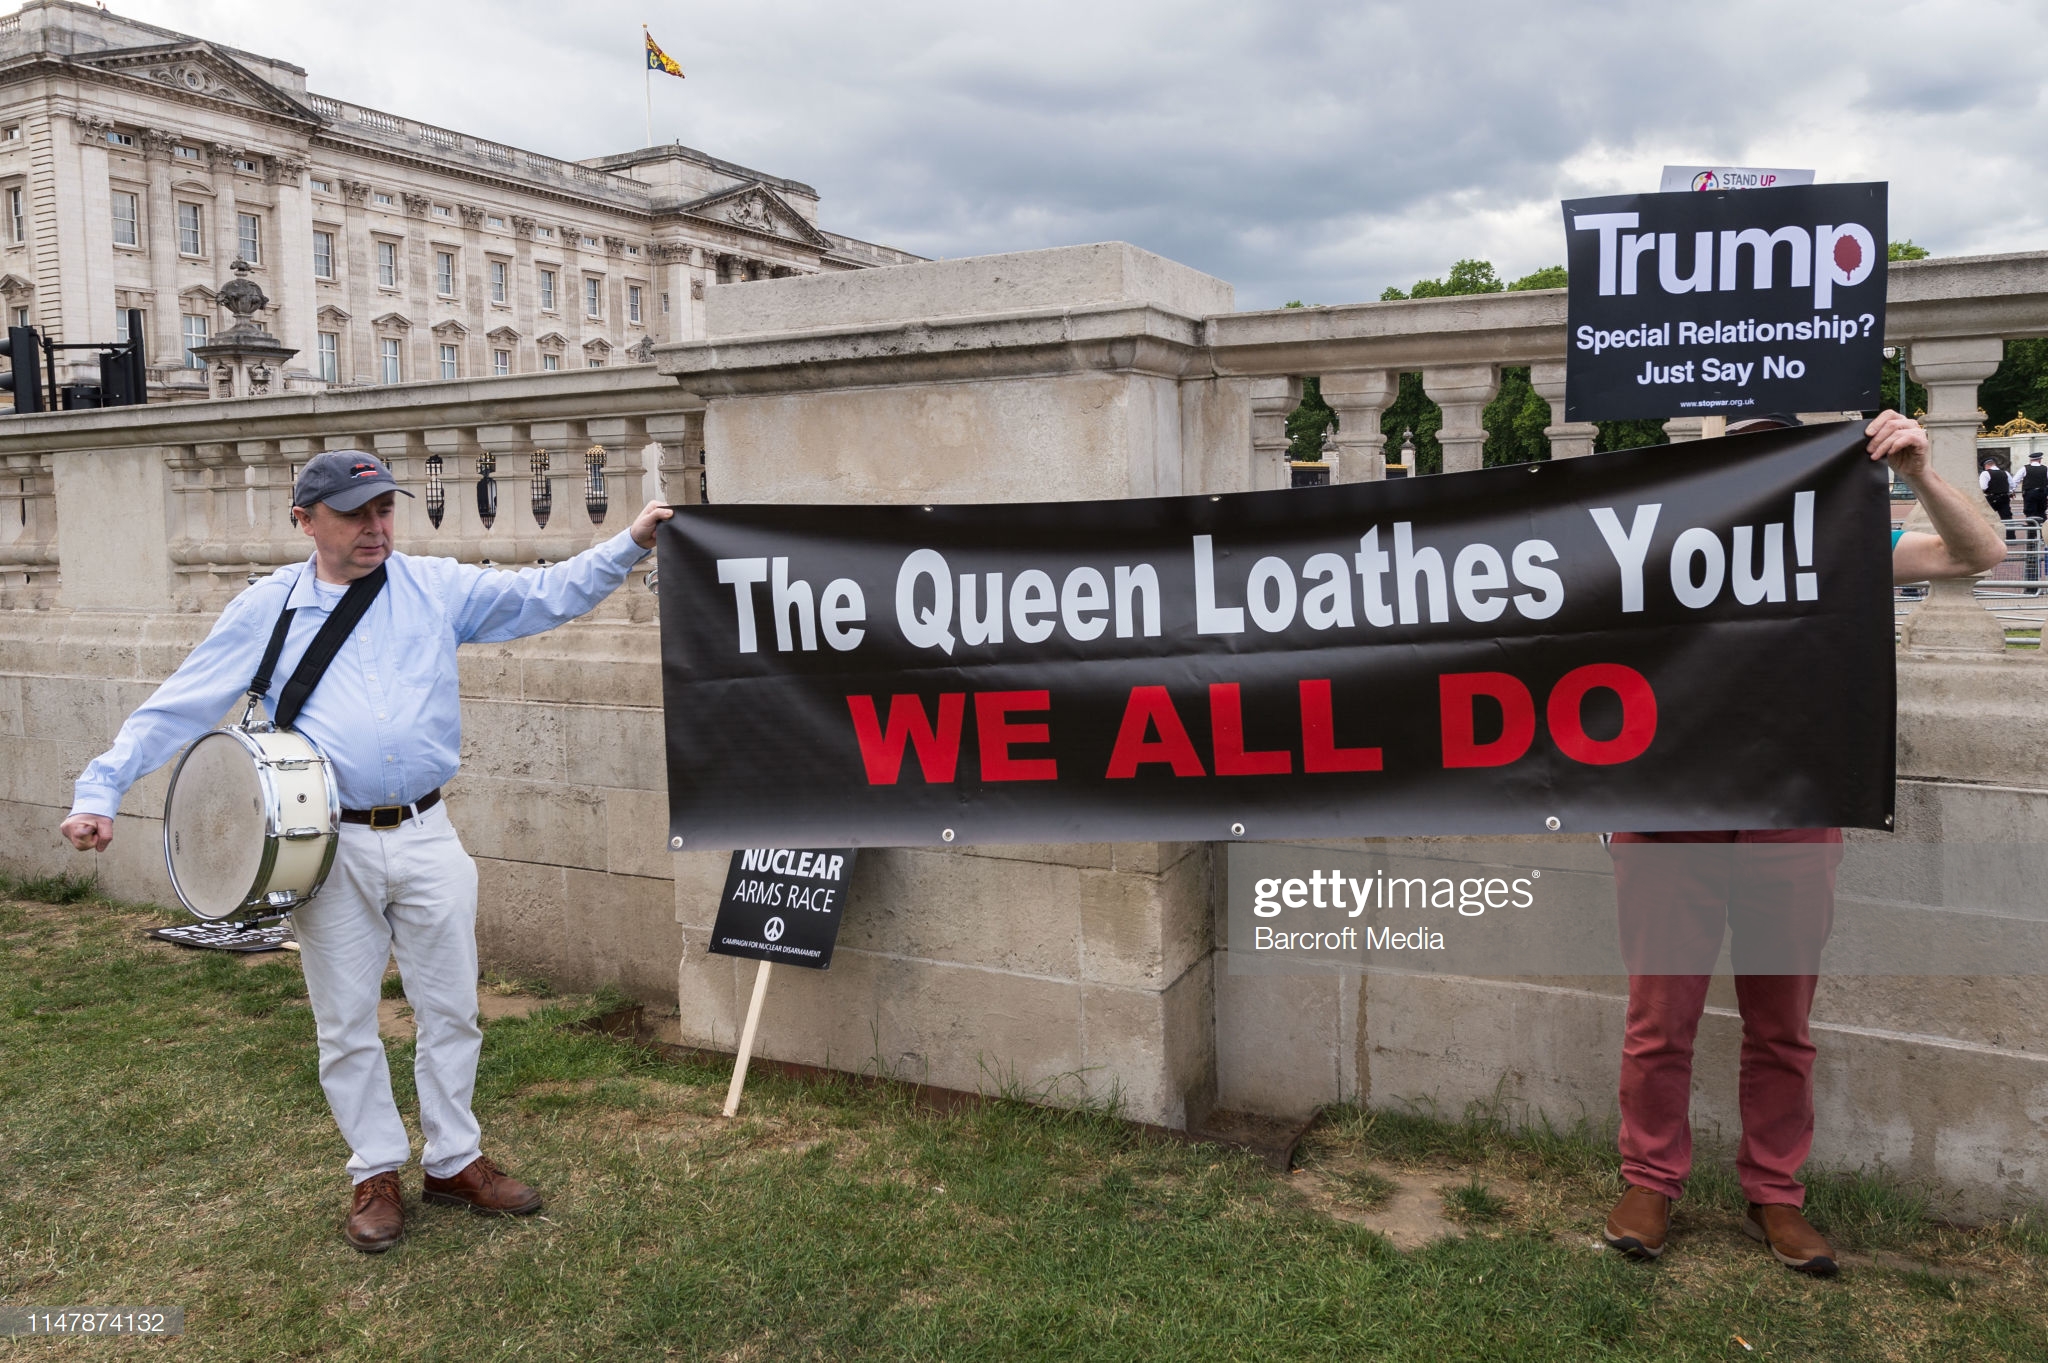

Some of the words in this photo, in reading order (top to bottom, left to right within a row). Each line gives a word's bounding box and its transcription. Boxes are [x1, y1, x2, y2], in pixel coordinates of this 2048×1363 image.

[1723, 173, 1758, 186] STAND
[1760, 175, 1777, 187] UP
[1574, 212, 1875, 309] Trump
[1576, 322, 1670, 355] Special
[1678, 312, 1875, 345] Relationship?
[1637, 360, 1695, 385] Just
[1701, 357, 1755, 387] Say
[1763, 355, 1806, 380] No
[1680, 398, 1755, 408] www.stopwar.org.uk
[716, 556, 867, 654] The
[895, 548, 1162, 656] Queen
[1192, 521, 1565, 635] Loathes
[1588, 490, 1819, 613] You!
[846, 690, 1058, 785] WE
[1105, 679, 1383, 779] ALL
[1439, 663, 1658, 768] DO
[741, 848, 844, 881] NUCLEAR
[732, 879, 784, 906] ARMS
[786, 884, 836, 913] RACE
[721, 937, 749, 948] CAMPAIGN
[748, 941, 760, 950] FOR
[759, 942, 783, 953] NUCLEAR
[782, 945, 822, 959] DISARMAMENT
